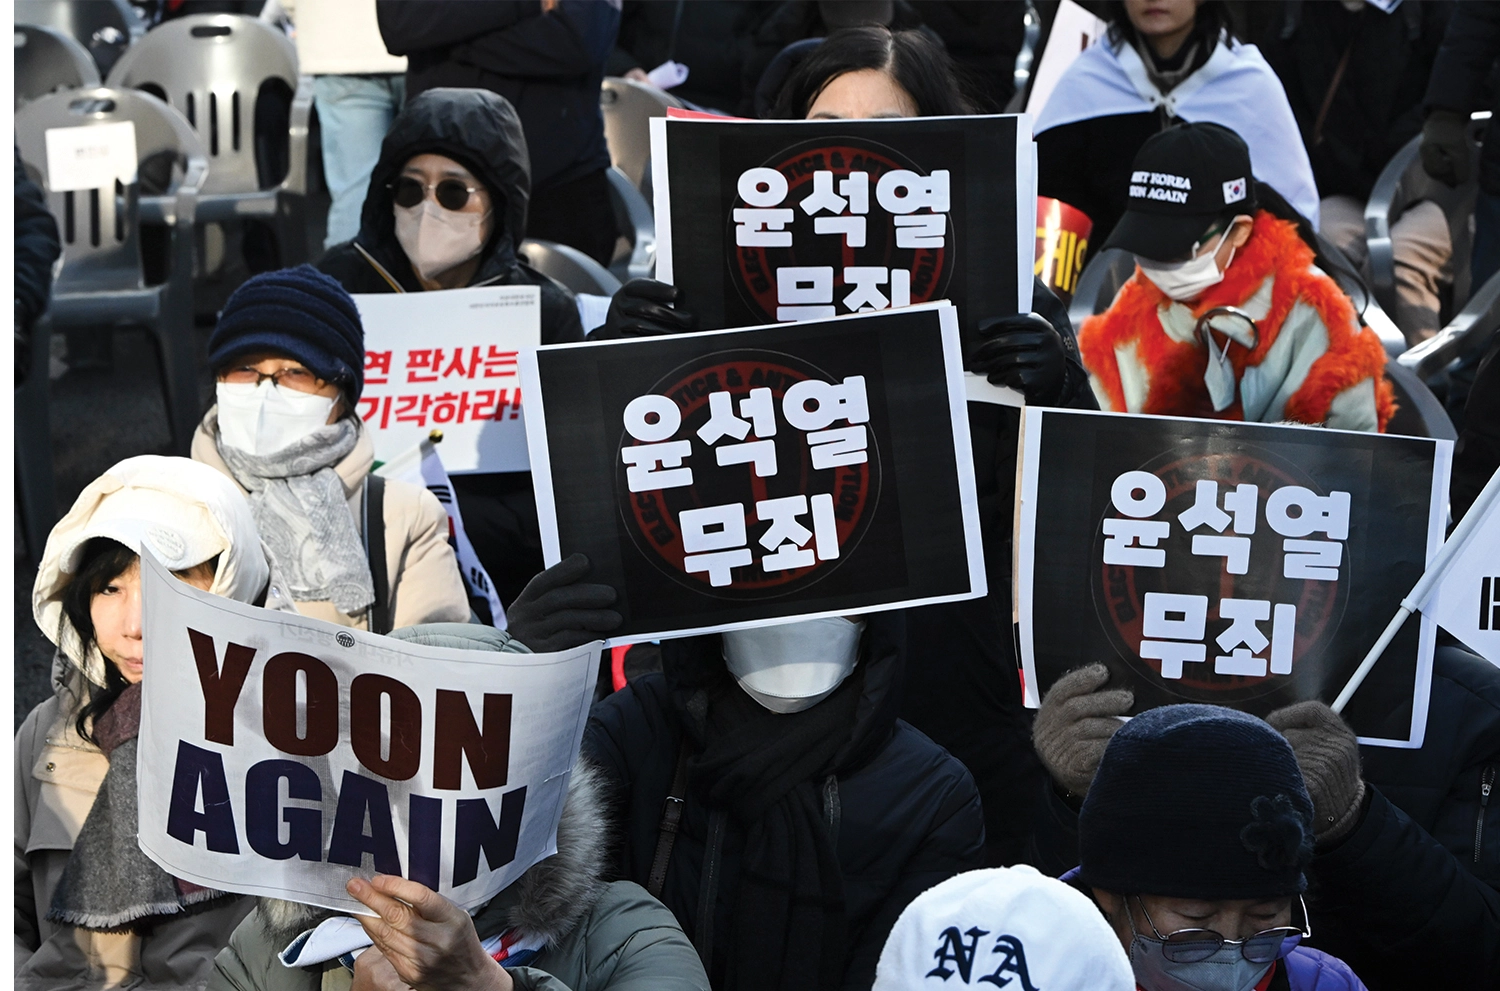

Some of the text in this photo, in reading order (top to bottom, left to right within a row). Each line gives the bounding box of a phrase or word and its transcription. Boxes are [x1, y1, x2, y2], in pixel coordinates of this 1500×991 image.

[786, 152, 826, 183] TICE
[1147, 187, 1189, 204] AGAIN
[1150, 172, 1192, 190] KOREA
[733, 167, 950, 248] 윤석열
[406, 345, 520, 383] 판사는
[673, 369, 721, 406] TICE
[750, 368, 791, 393] ANT
[359, 387, 523, 430] 기각하라!
[621, 375, 870, 493] 윤석열
[678, 493, 840, 587] 무죄
[1102, 470, 1351, 581] 윤석열
[1139, 592, 1297, 680] 무죄
[187, 626, 513, 791] YOON
[167, 739, 528, 892] AGAIN
[925, 926, 1041, 991] NA
